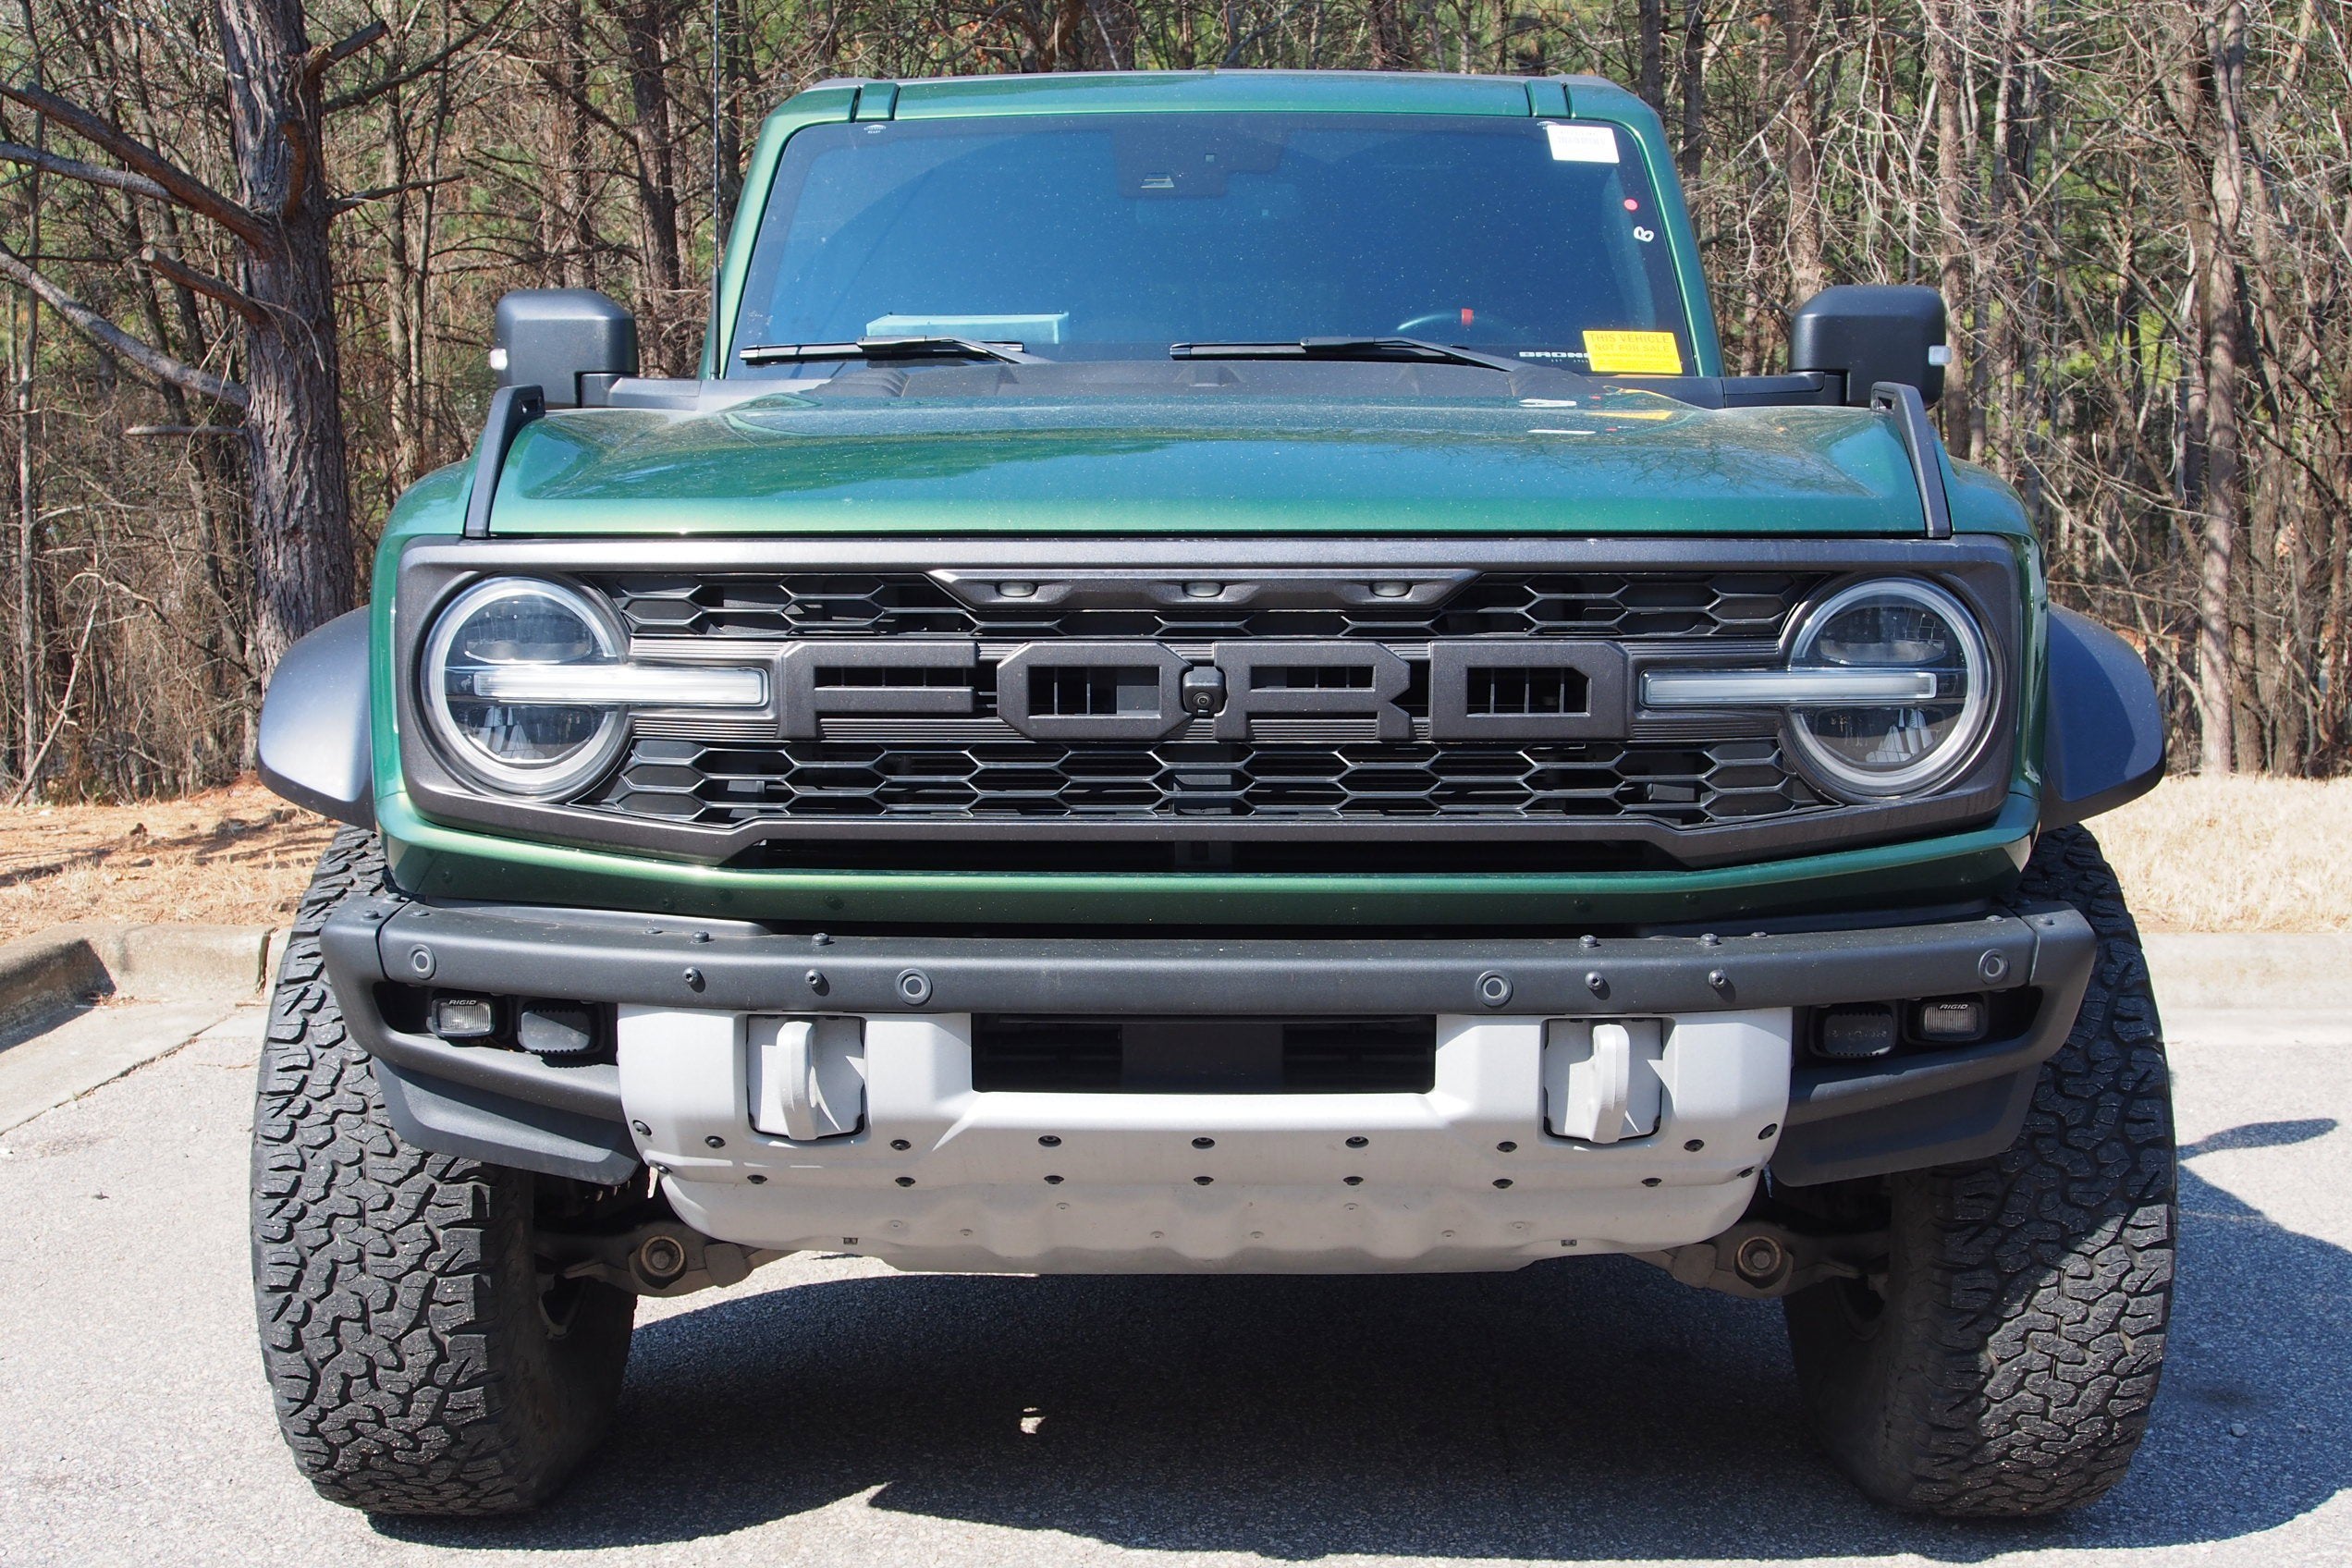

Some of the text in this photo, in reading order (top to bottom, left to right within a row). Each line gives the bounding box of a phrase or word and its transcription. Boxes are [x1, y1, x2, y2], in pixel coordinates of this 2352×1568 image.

[1588, 333, 1672, 344] THIS VEHICLE
[776, 641, 1629, 740] FORD
